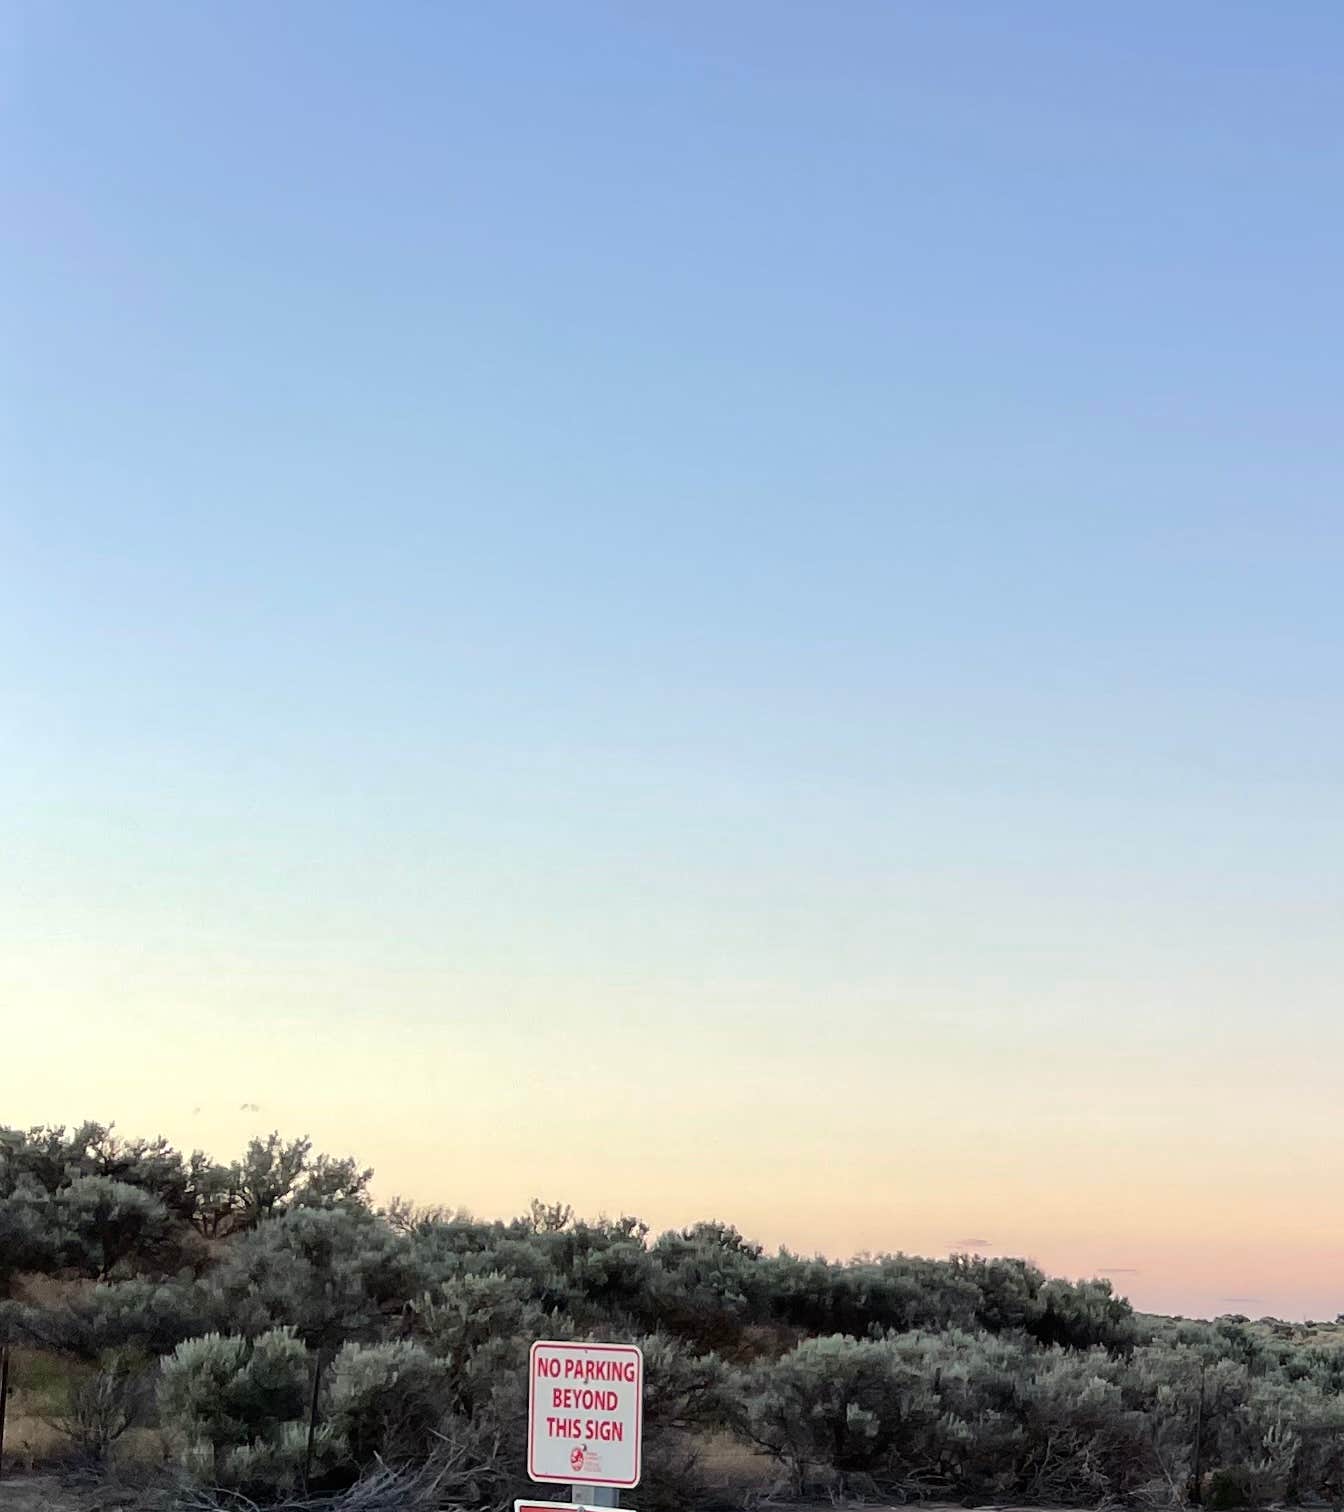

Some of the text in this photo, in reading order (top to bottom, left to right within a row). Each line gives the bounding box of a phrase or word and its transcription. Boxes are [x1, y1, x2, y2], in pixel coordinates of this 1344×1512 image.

[538, 1358, 635, 1382] NO PARKING
[552, 1388, 618, 1411] BEYOND
[546, 1417, 624, 1441] THIS SIGN
